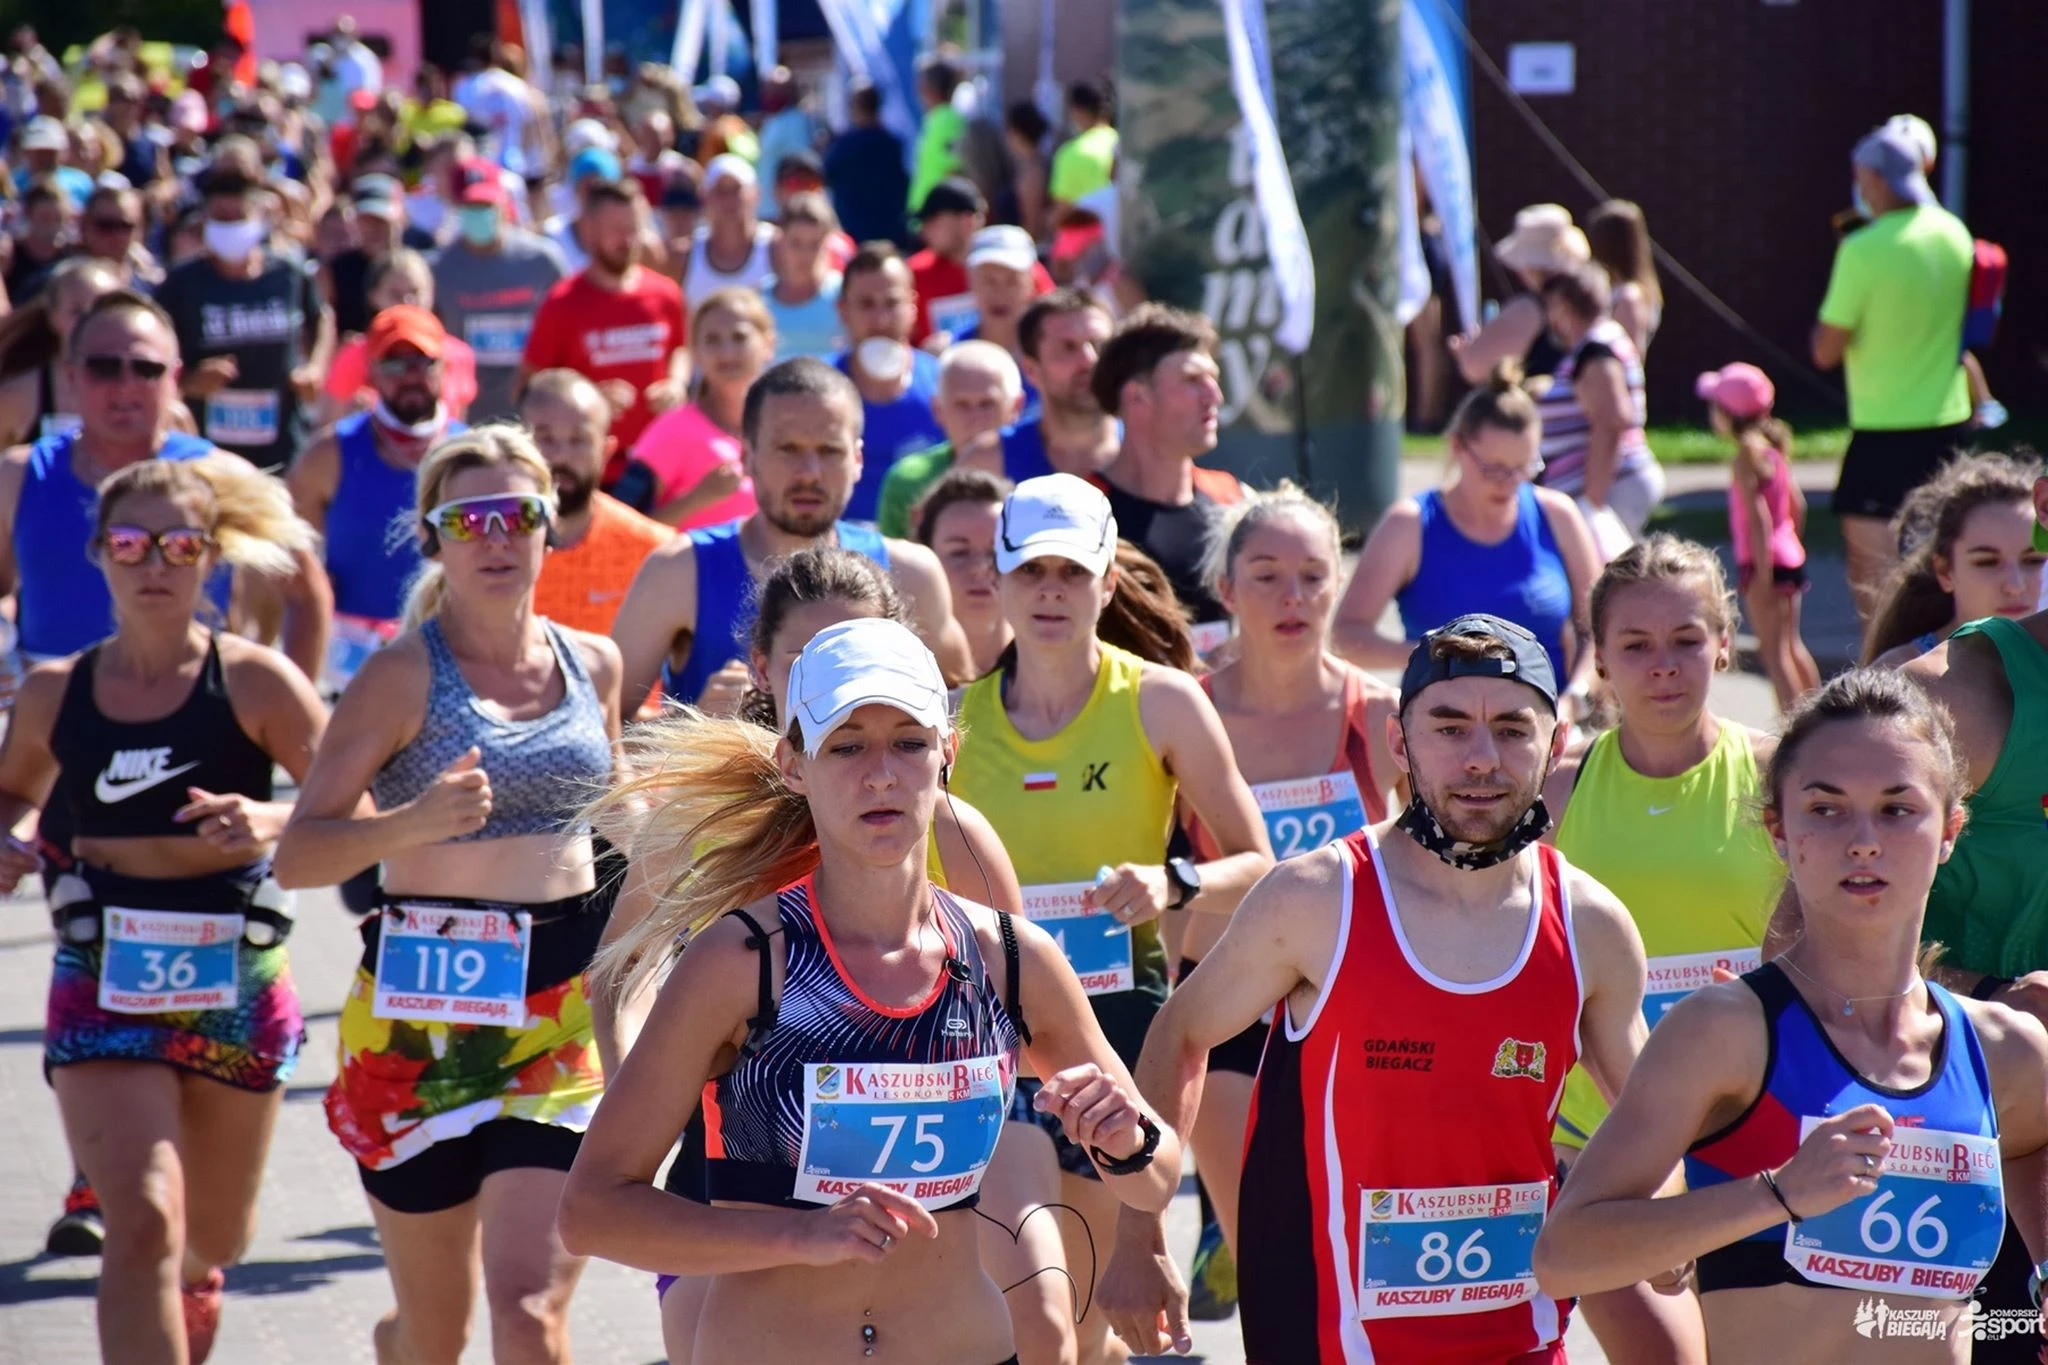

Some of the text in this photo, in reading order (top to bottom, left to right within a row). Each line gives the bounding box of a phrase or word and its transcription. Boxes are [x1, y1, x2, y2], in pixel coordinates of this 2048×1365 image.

[107, 746, 172, 781] NIKE
[1275, 812, 1336, 858] 22
[137, 950, 198, 992] 36
[415, 945, 486, 994] 119
[1079, 973, 1118, 989] EGAJĄ
[1647, 966, 1714, 981] ASZUBSKI
[1363, 1037, 1436, 1055] GDAŃSKI
[1365, 1056, 1433, 1072] BIEGACZ
[846, 1067, 952, 1095] KASZUBSKI
[953, 1064, 994, 1089] BIEG
[948, 1090, 955, 1100] 5
[956, 1088, 971, 1099] KM
[870, 1114, 945, 1174] 75
[1888, 1143, 1995, 1170] ZUBSKI BIEG
[913, 1174, 975, 1199] BIEGAJĄ
[1947, 1170, 1954, 1181] 5
[1955, 1171, 1971, 1182] KM
[1397, 1187, 1541, 1215] KASZUBSKI BIEG
[1860, 1189, 1949, 1258] 66
[1416, 1228, 1492, 1282] 86
[1806, 1253, 1905, 1284] KASZUBY
[1376, 1282, 1525, 1307] KASZUBY BIEGAJĄ
